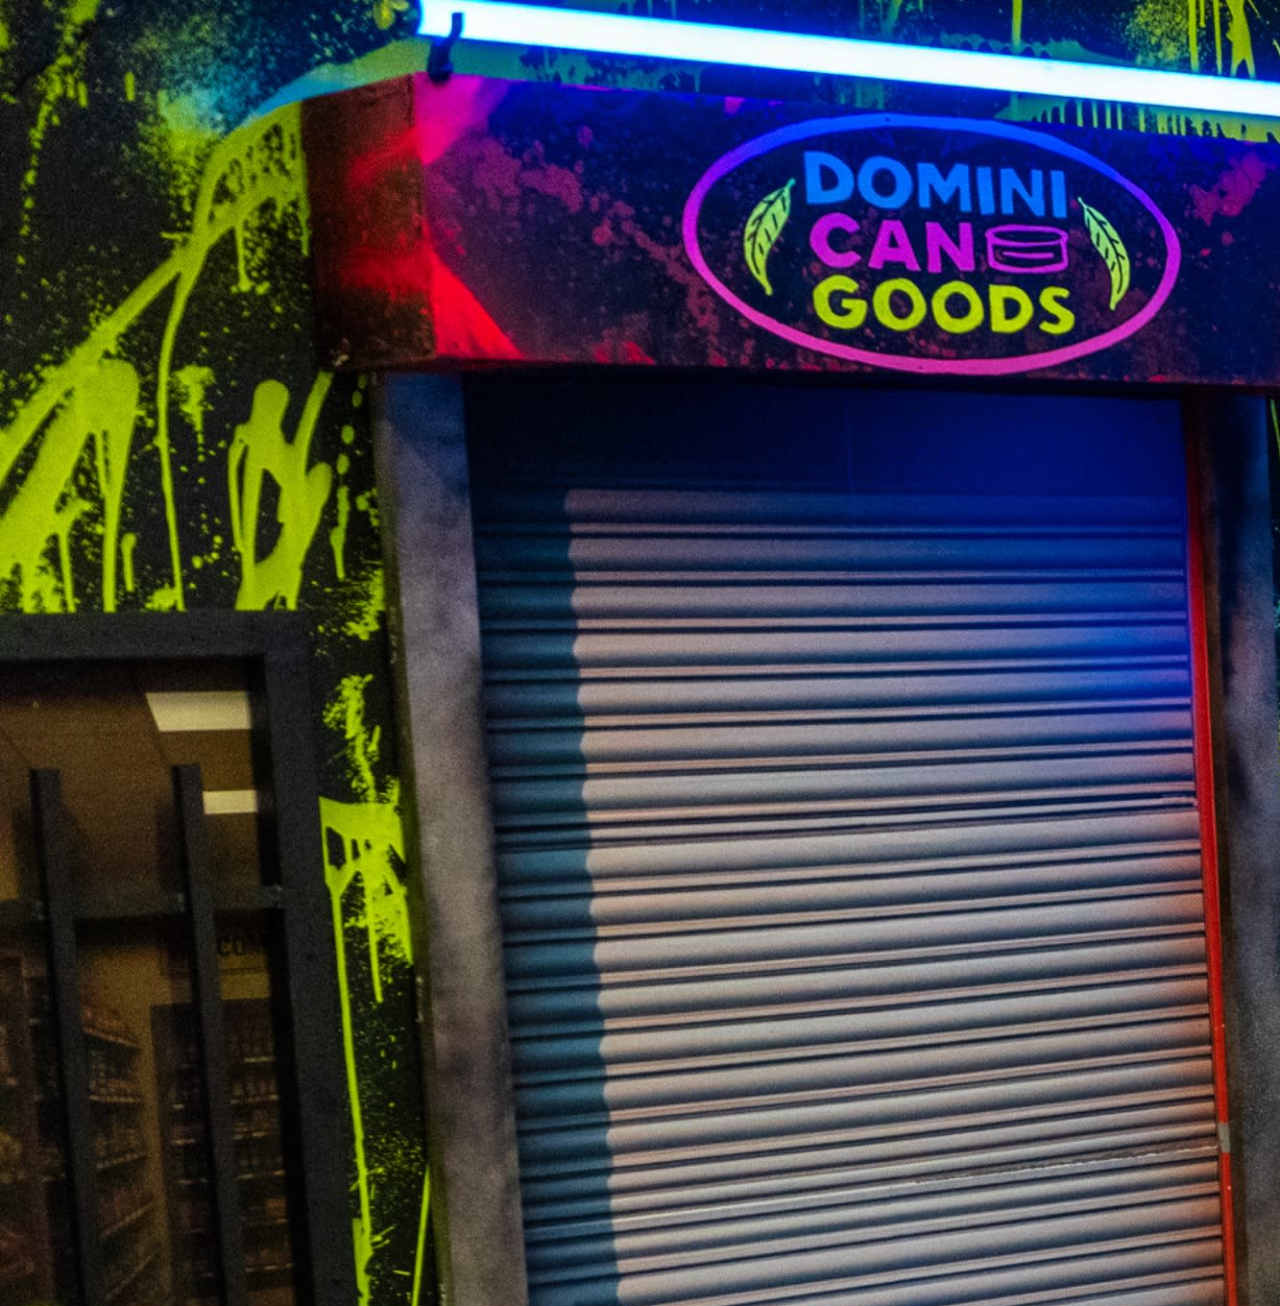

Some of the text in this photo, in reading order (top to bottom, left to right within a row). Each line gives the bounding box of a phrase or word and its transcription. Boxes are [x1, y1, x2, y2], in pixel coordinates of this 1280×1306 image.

[803, 150, 1068, 219] DOMINI
[808, 211, 976, 273] CAN
[811, 274, 1076, 335] GOODS
